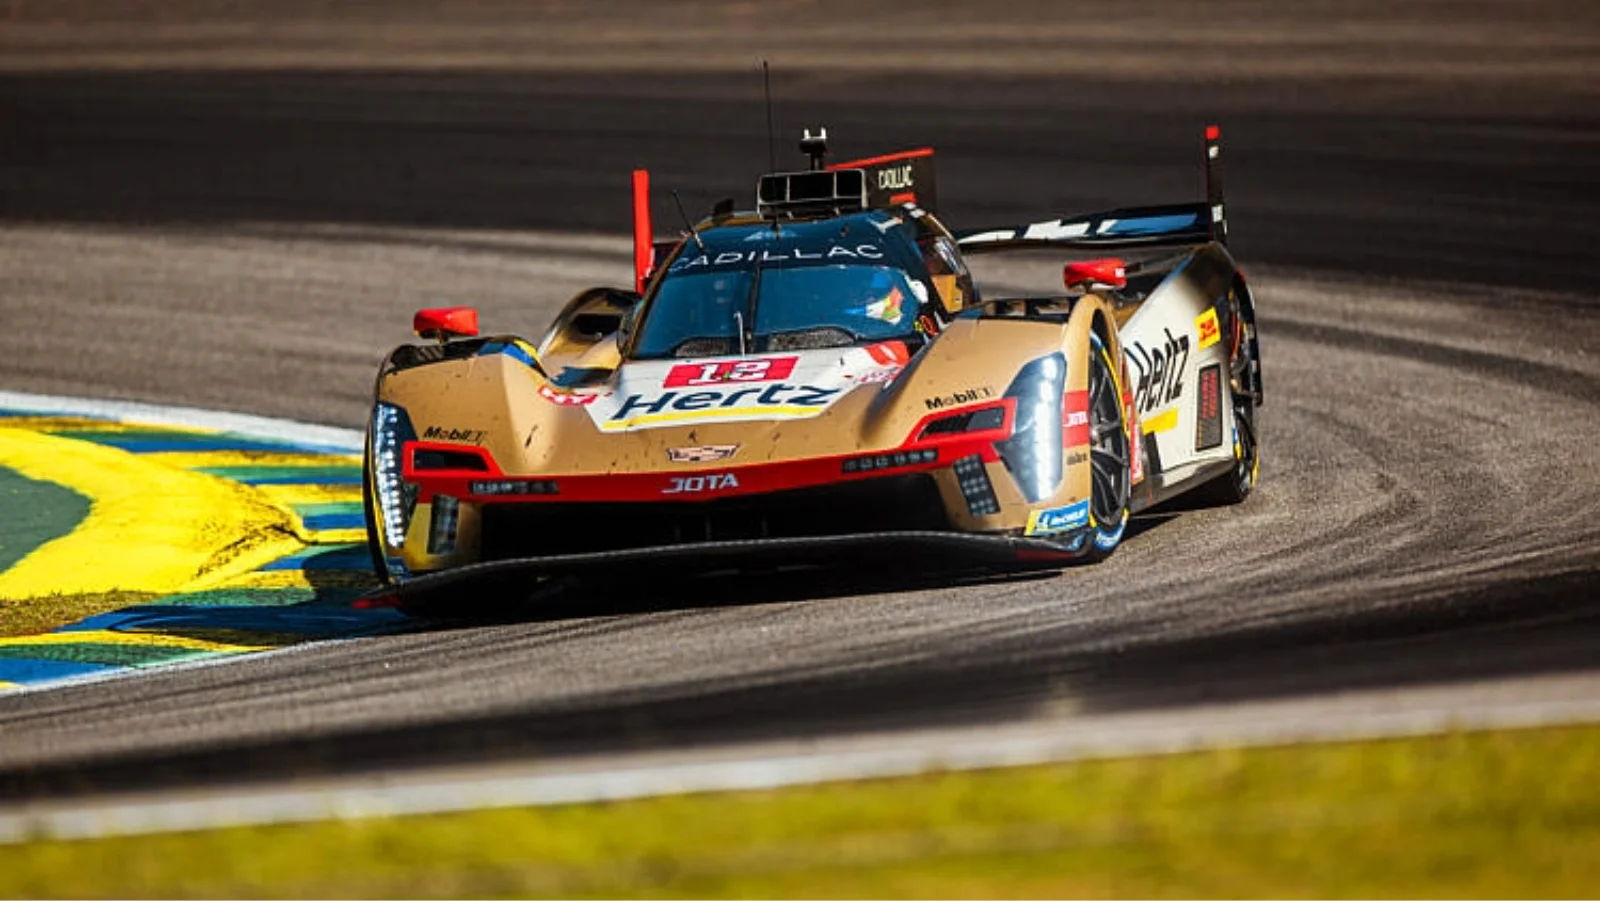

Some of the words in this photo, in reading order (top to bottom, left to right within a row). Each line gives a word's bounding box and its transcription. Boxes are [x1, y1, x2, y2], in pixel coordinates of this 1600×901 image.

[669, 244, 883, 272] CADILLAC
[688, 361, 772, 384] 12
[1124, 327, 1188, 414] Hertz
[611, 384, 842, 420] Hertz
[661, 473, 739, 494] JOTA
